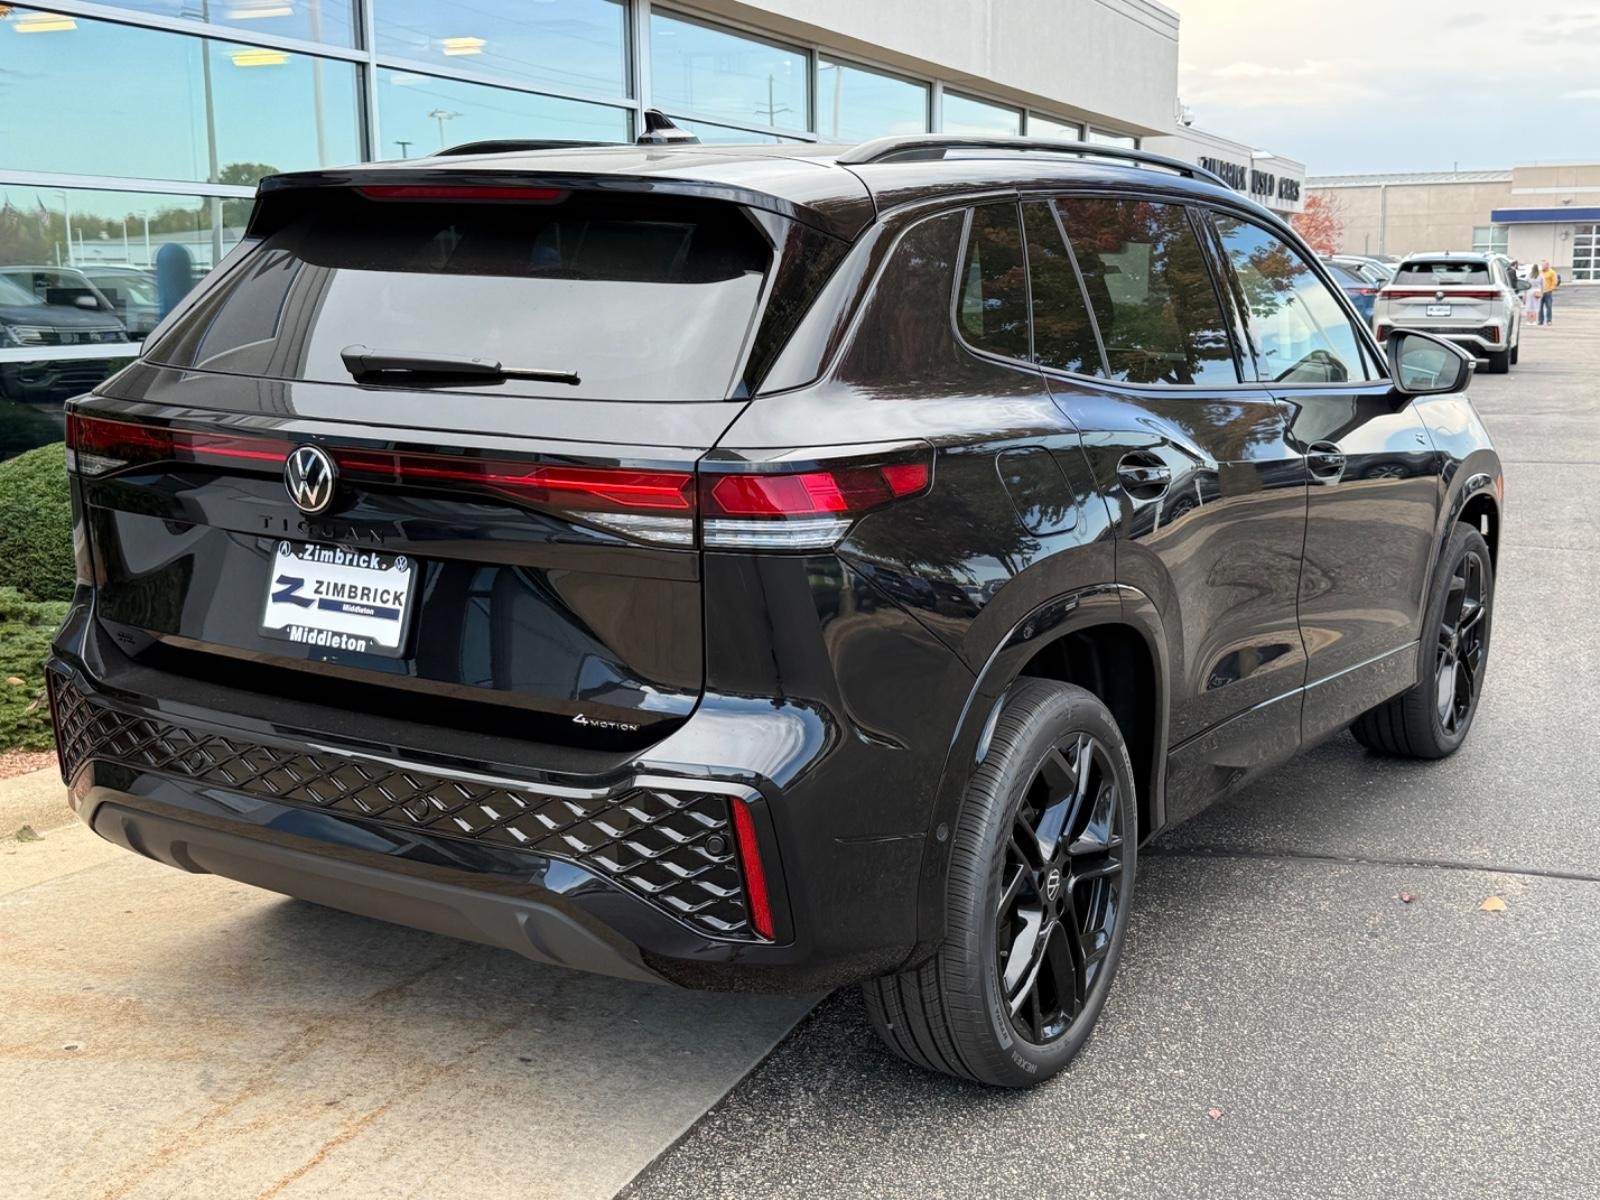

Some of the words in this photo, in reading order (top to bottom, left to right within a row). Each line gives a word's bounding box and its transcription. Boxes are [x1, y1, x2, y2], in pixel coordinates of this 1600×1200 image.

[303, 544, 380, 570] Zimbrick
[314, 580, 405, 607] ZIMBRICK
[342, 603, 375, 616] Middleton
[289, 625, 367, 653] Middleton
[1011, 1050, 1038, 1074] NEXEN
